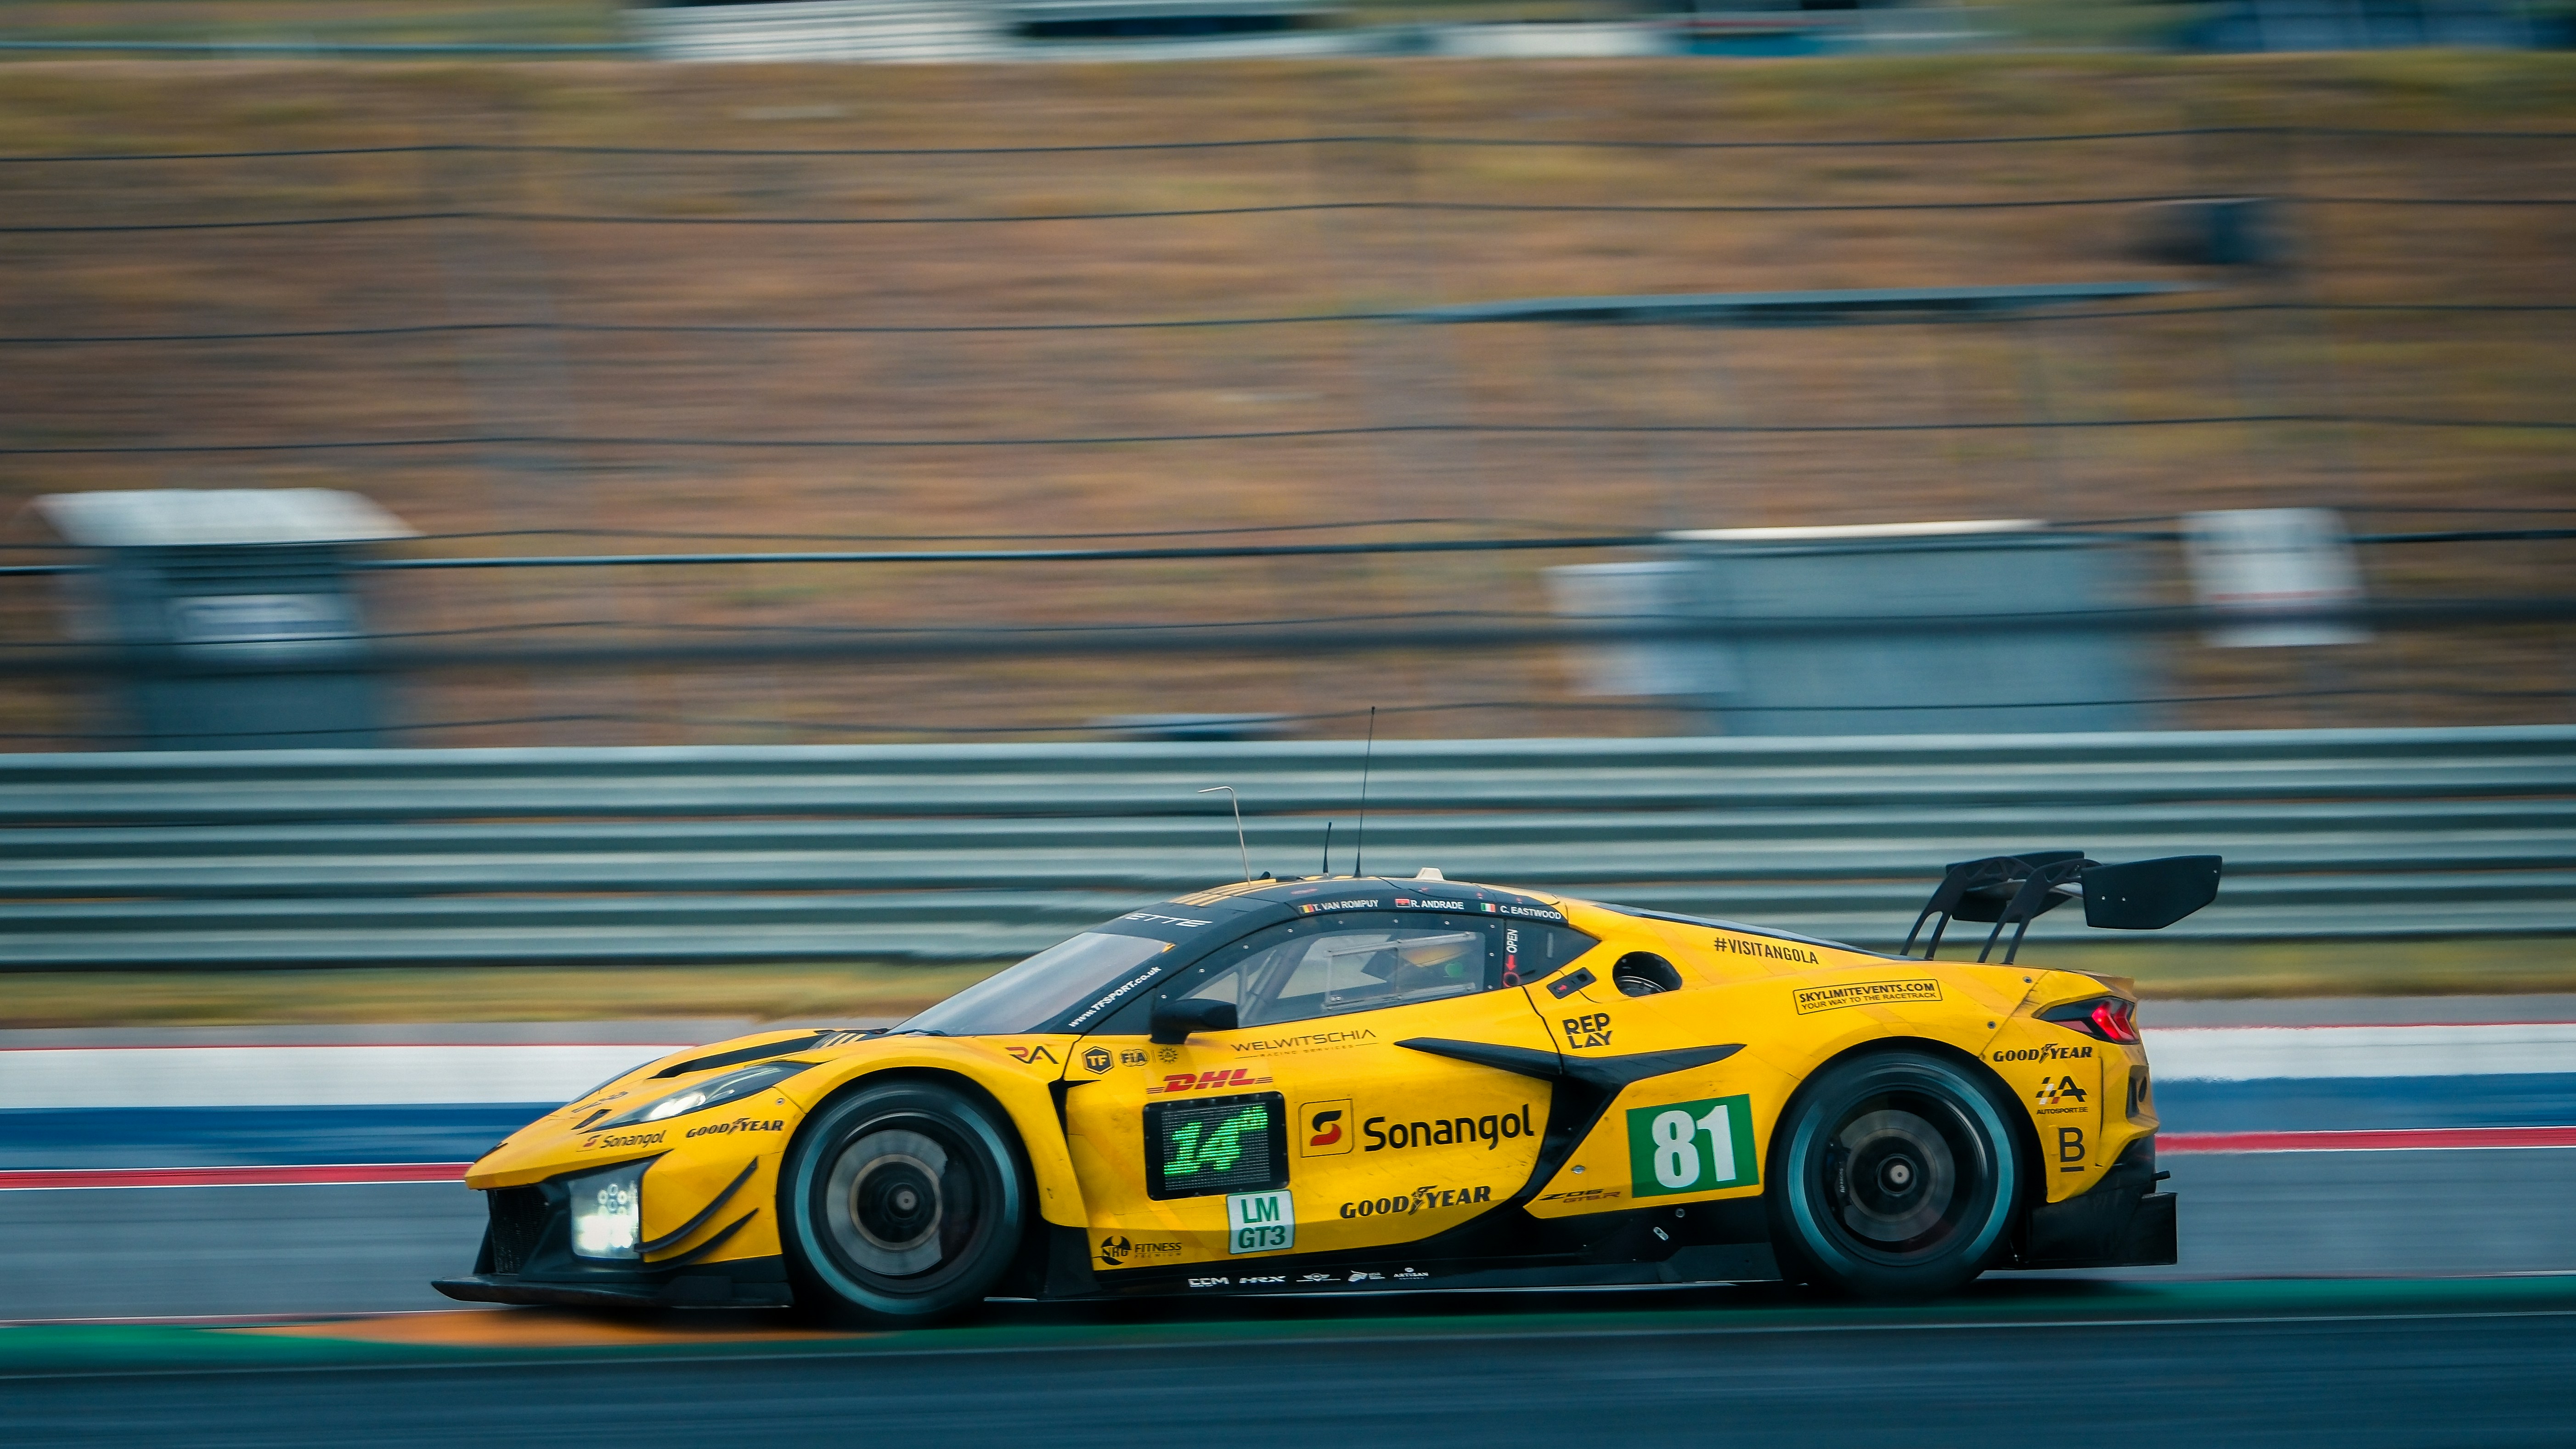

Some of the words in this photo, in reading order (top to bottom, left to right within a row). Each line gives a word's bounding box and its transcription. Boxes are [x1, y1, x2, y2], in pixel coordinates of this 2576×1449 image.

[1321, 901, 1341, 910] VAN
[1342, 899, 1379, 909] ROMPUY
[1410, 900, 1420, 908] R.
[1421, 900, 1465, 910] ANDRADE
[1500, 905, 1510, 914] C.
[1511, 907, 1561, 920] EASTWOOD
[1506, 929, 1518, 953] OPEN
[1714, 937, 1819, 965] #VISITANGOLA
[1799, 983, 1935, 1003] SKYLIMITEVENTS.COM
[1801, 1001, 1826, 1010] YOUR
[1231, 1029, 1376, 1052] WELWITSCHIA
[1087, 1054, 1108, 1066] TF
[1993, 1043, 2093, 1064] GOODYEAR
[1163, 1069, 1256, 1093] DHL
[2036, 1106, 2088, 1115] AUTOSPORT.BE
[685, 1118, 784, 1138] GOODYEAR
[1363, 1103, 1535, 1152] Sonangol
[599, 1130, 666, 1148] Sonangol
[1652, 1105, 1737, 1188] 81
[2058, 1127, 2086, 1163] B
[1241, 1196, 1280, 1224] LM
[1340, 1185, 1492, 1219] GOODYEAR
[1134, 1242, 1182, 1253] FITNESS
[1238, 1225, 1285, 1249] GT3
